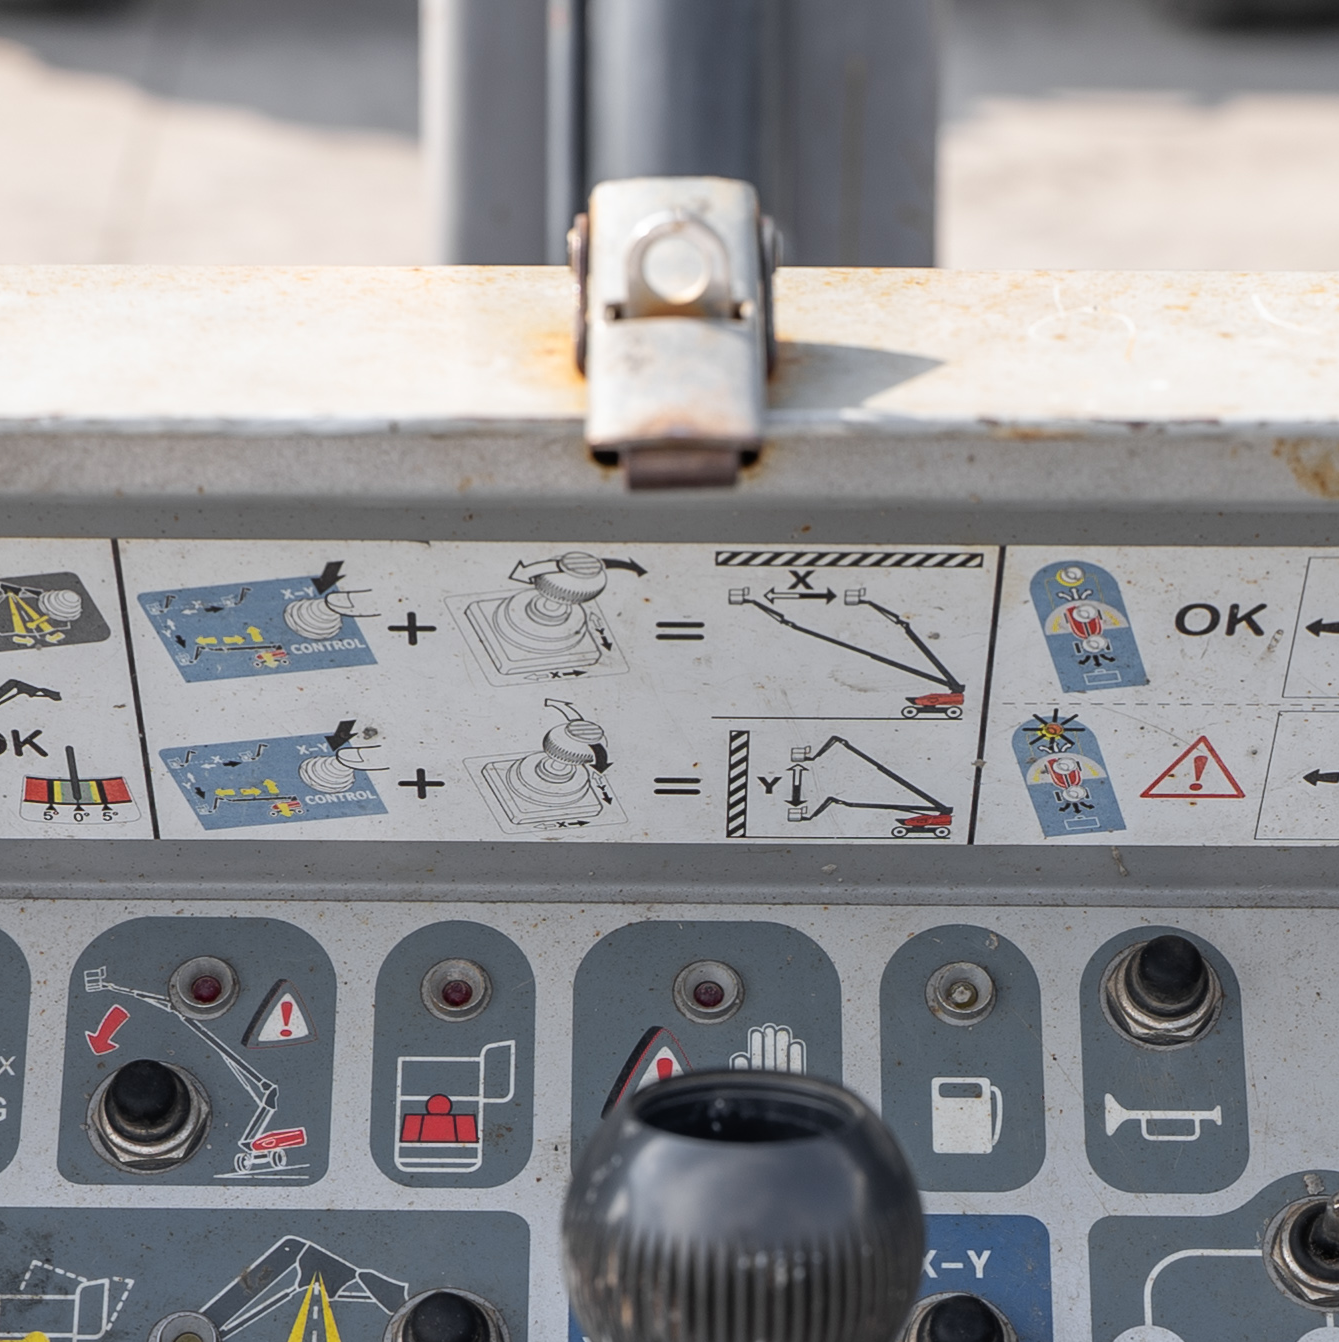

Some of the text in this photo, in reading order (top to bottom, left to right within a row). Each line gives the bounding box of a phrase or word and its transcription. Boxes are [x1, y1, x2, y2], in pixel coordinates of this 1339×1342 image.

[787, 569, 816, 590] X
[1174, 603, 1268, 637] OK
[290, 638, 367, 655] CONTROL
[756, 776, 783, 795] Y
[305, 790, 378, 805] CONTROL
